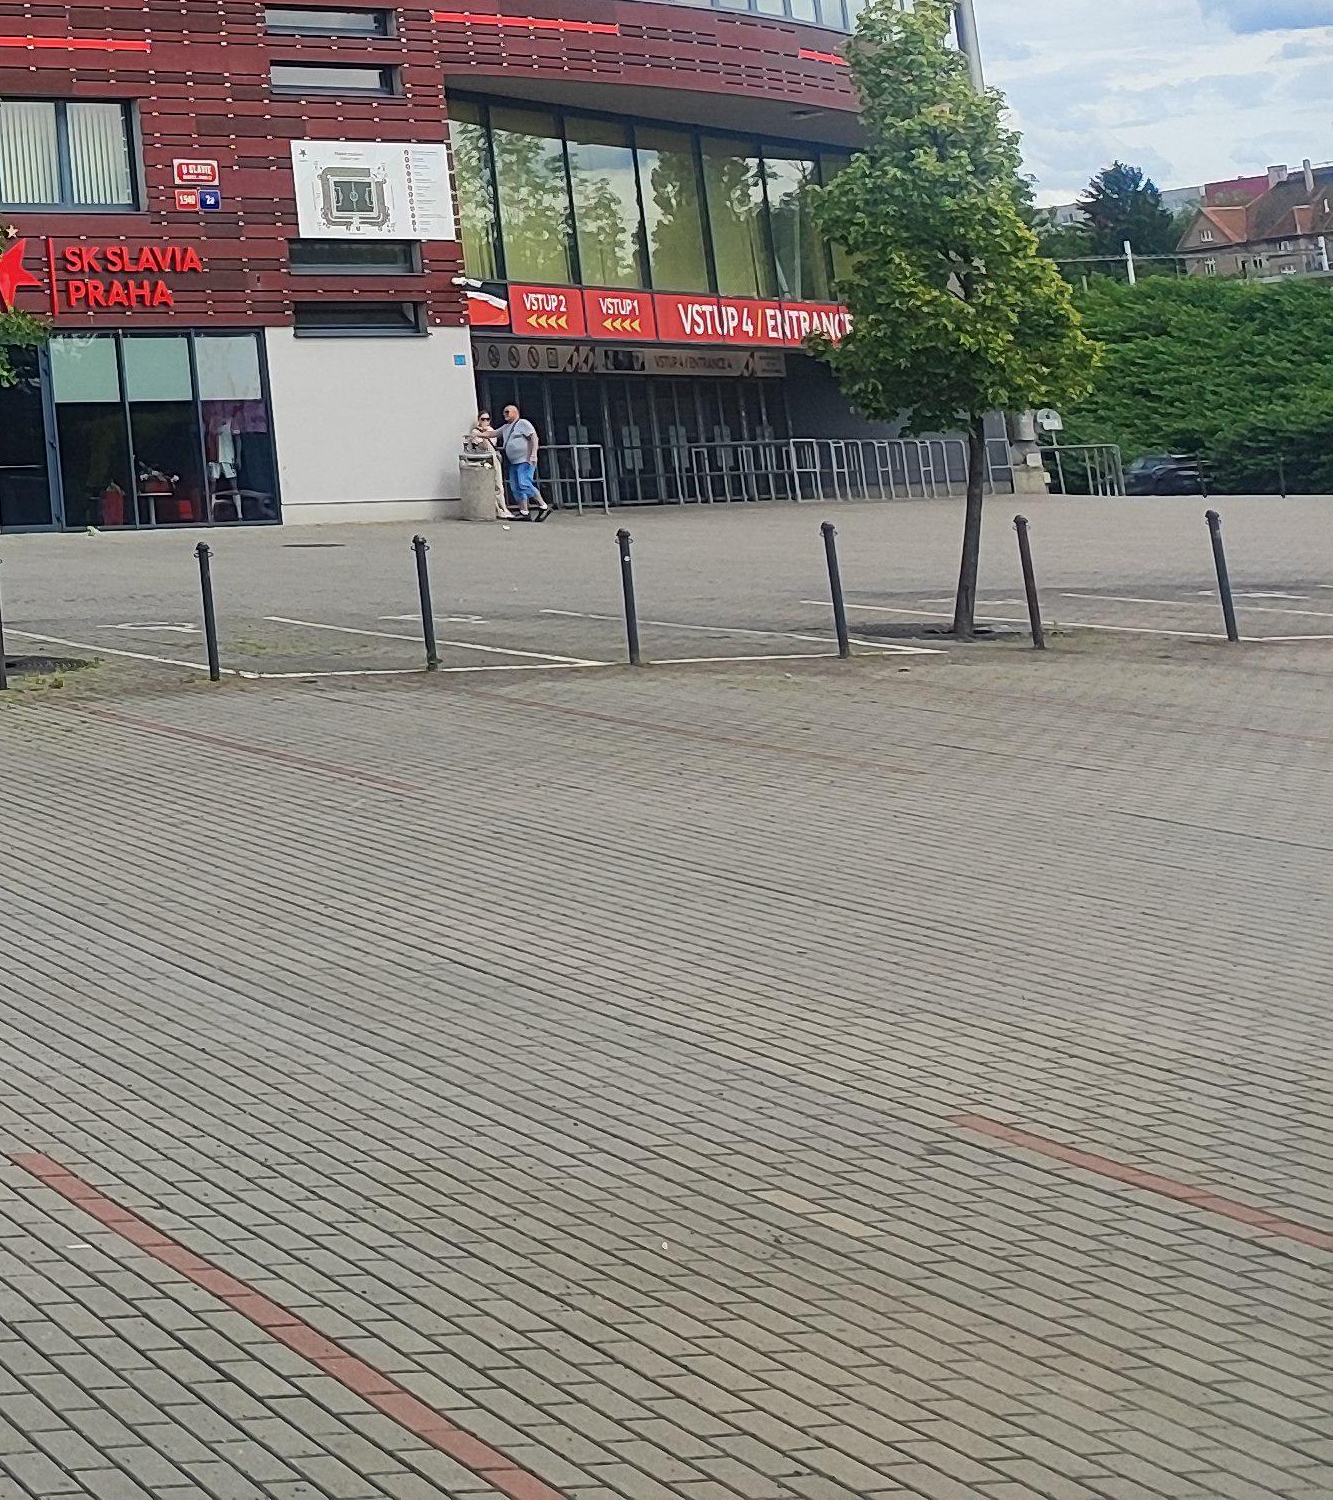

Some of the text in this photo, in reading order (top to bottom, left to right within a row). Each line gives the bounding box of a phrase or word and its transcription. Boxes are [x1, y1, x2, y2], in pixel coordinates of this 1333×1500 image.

[188, 165, 213, 176] SLAVIE
[65, 246, 203, 273] SK SLAVIA
[68, 279, 174, 307] PRAHA
[523, 293, 567, 312] VSTUP 2
[599, 298, 639, 316] VSTUP 1
[677, 303, 737, 337] VSTUP
[740, 307, 752, 338] 4
